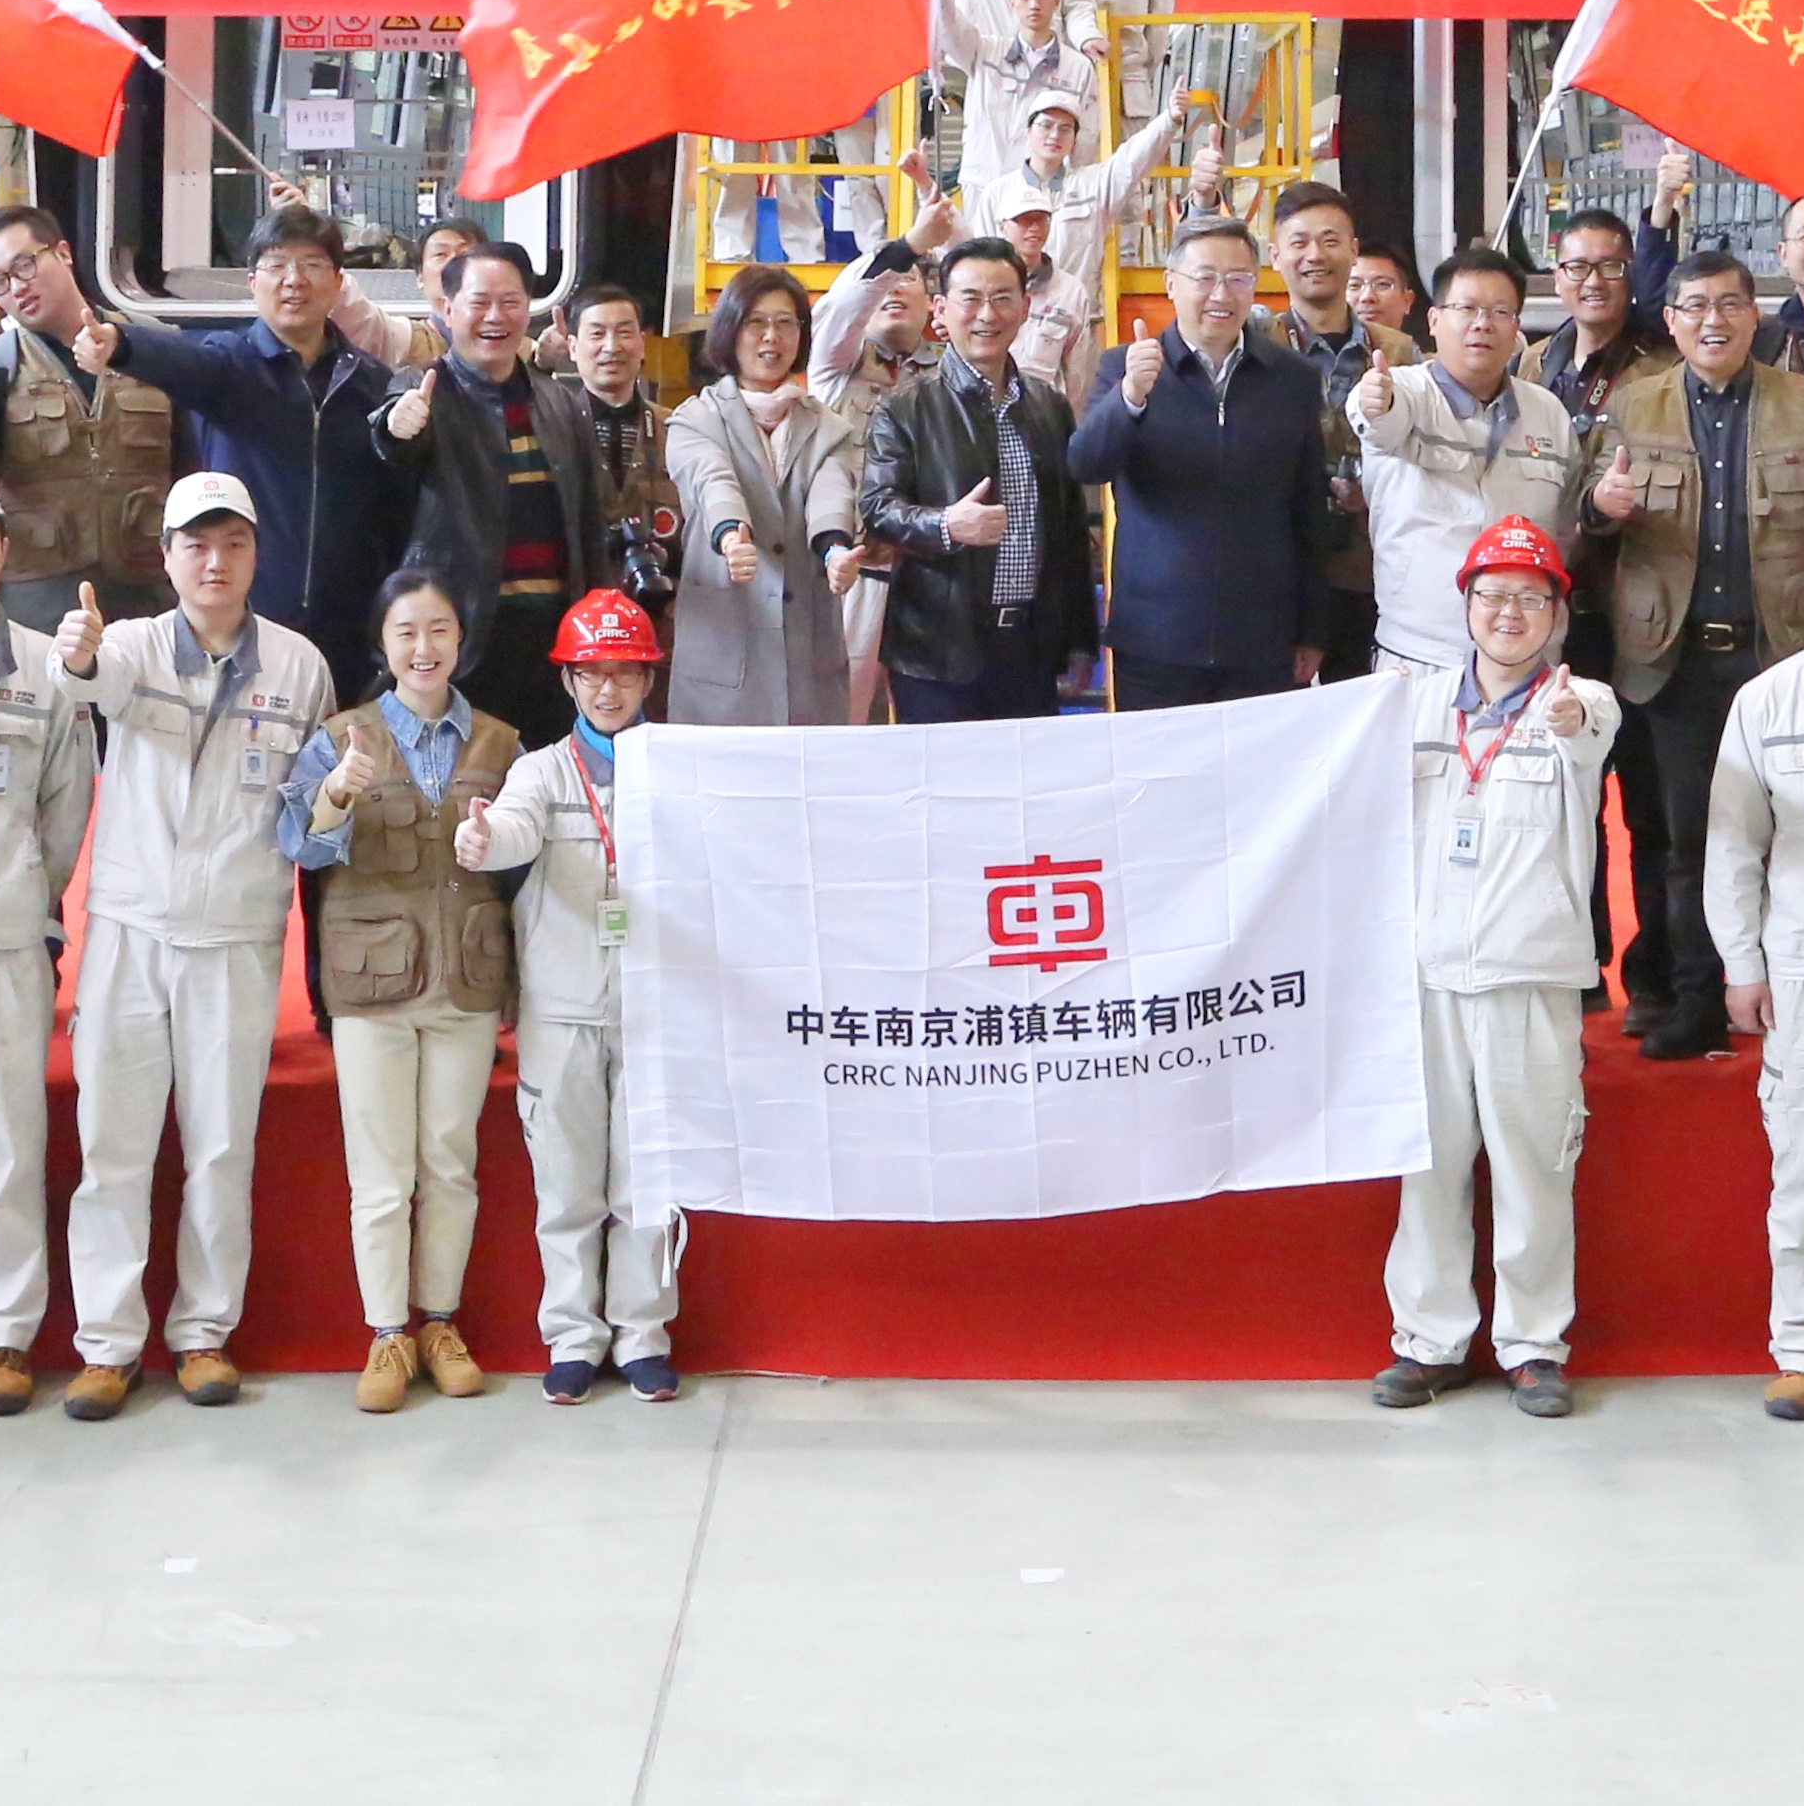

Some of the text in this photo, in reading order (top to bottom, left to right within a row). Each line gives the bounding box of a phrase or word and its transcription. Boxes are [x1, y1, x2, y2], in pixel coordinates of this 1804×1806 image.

[1589, 378, 1608, 406] EOS
[785, 969, 1307, 1048] 中车南京浦镇车辆有限公司
[823, 1032, 1276, 1087] CRRC NANJING PUZHEN CO., LTD.
